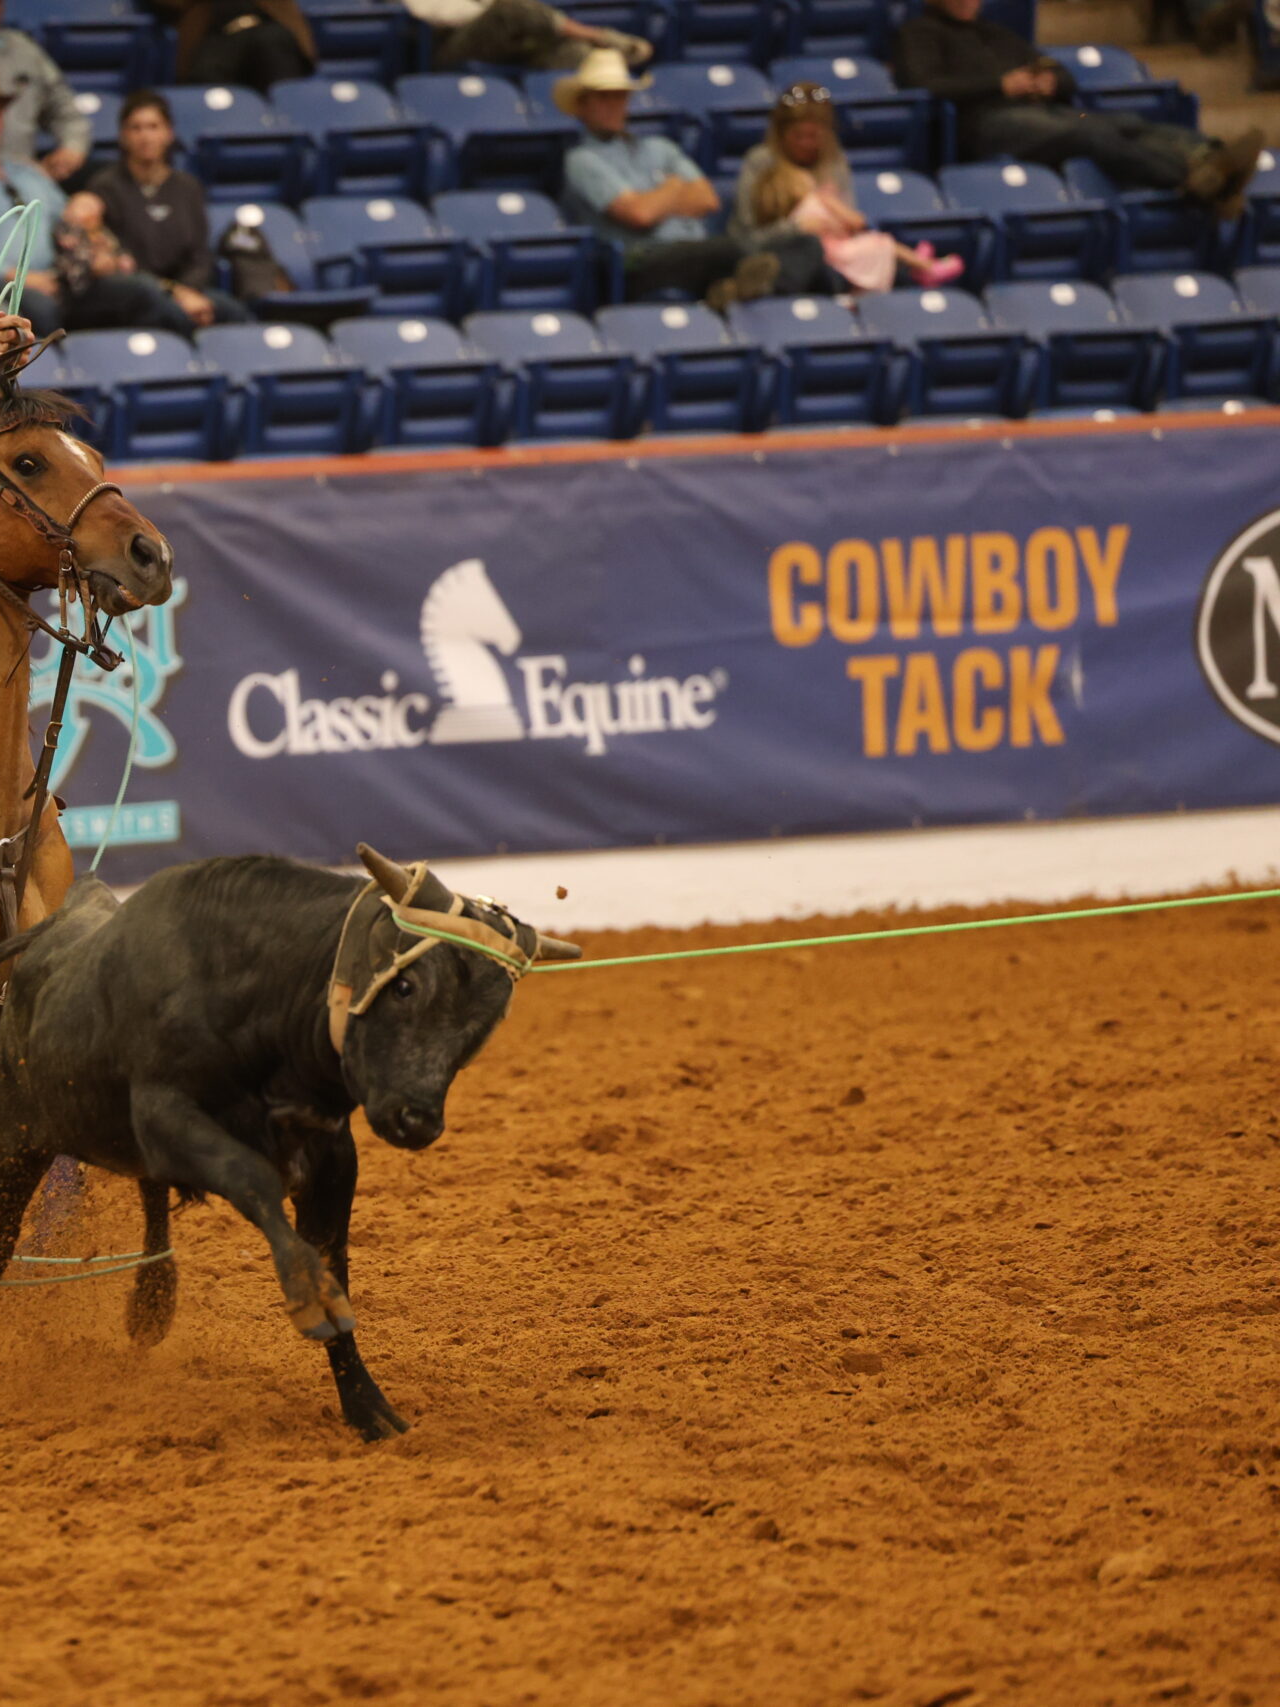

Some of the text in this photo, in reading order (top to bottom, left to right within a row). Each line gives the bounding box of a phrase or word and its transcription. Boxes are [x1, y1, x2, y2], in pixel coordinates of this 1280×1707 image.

[768, 524, 1130, 648] COWBOY
[227, 668, 431, 760] Classic
[518, 654, 718, 756] Equine
[846, 644, 1066, 758] TACK
